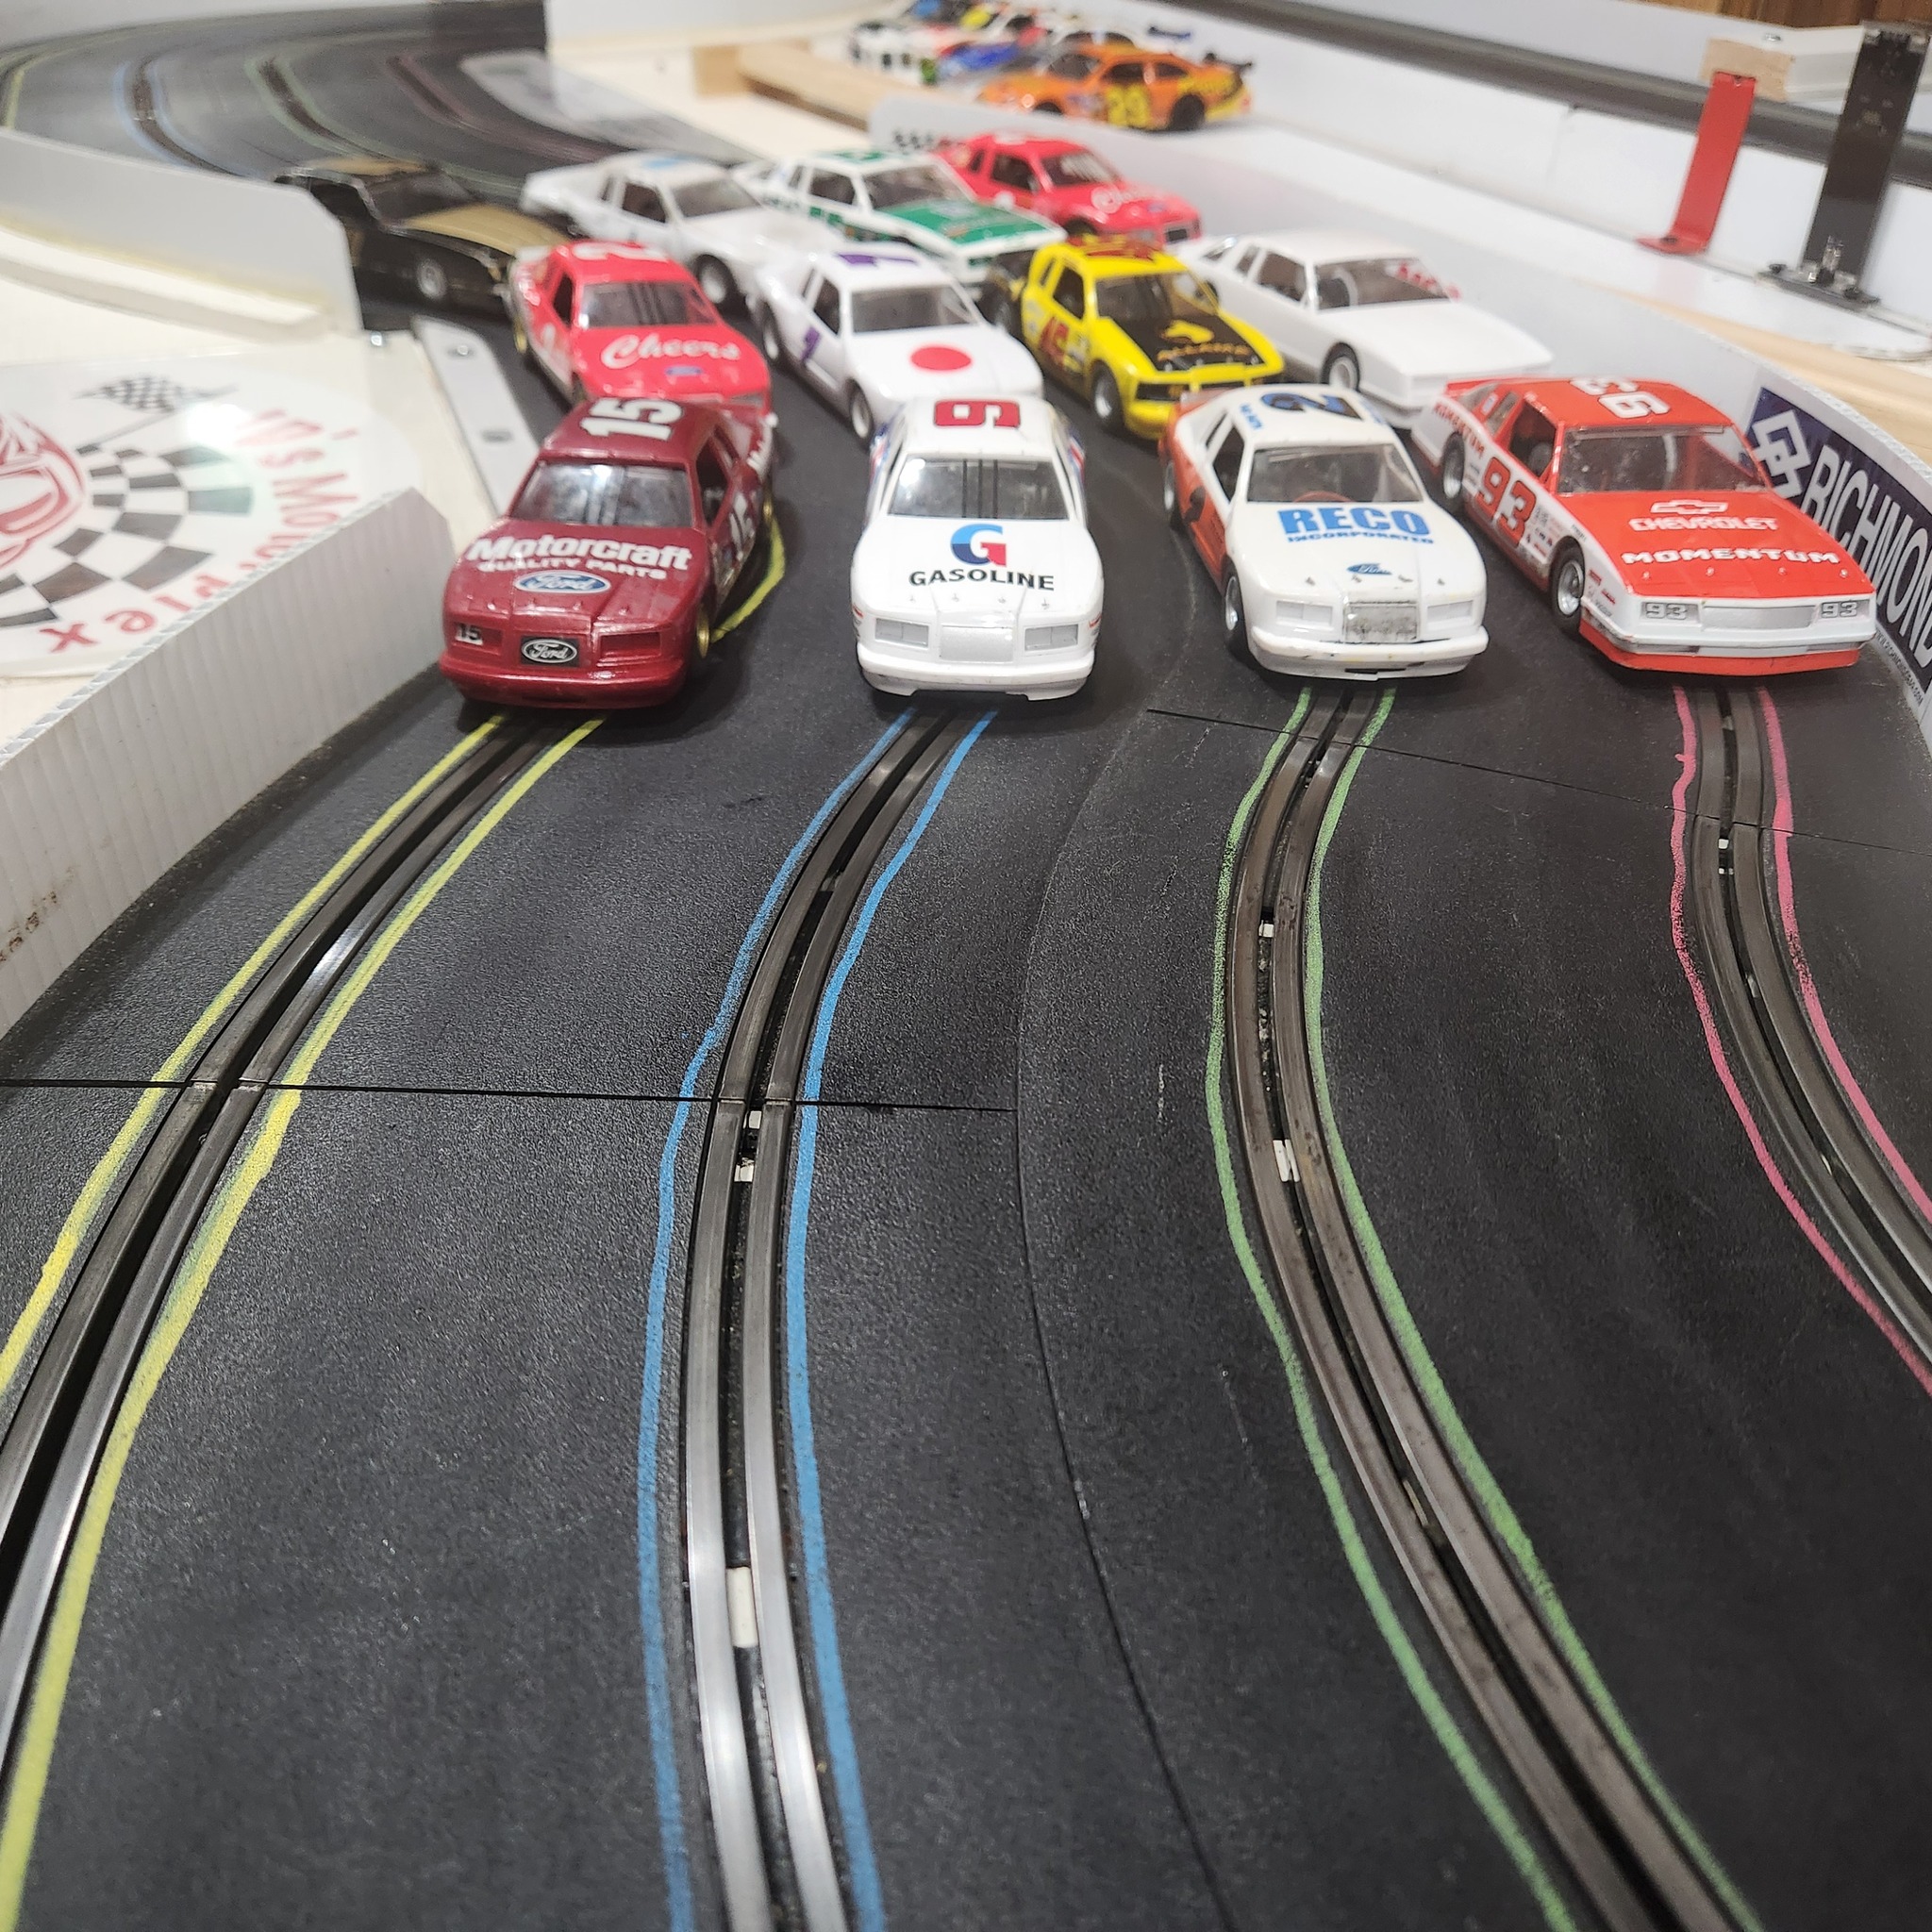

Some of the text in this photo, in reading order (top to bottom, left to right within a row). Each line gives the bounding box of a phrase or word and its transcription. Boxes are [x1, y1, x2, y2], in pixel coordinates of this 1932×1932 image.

[581, 398, 684, 441] 15
[1474, 457, 1537, 548] 93
[1278, 507, 1431, 536] RECO
[1629, 516, 1778, 531] CHEVROLET
[951, 524, 1007, 567] G
[1287, 530, 1434, 545] INCORPORATED
[466, 534, 692, 571] Motorcraft
[1621, 548, 1840, 564] MOMENTUM
[476, 557, 668, 580] QUALITY PARTS
[908, 569, 1055, 591] GASOLINE
[1645, 602, 1688, 620] 93
[1821, 602, 1858, 619] 93
[457, 624, 482, 641] 15
[527, 641, 572, 660] Ford
